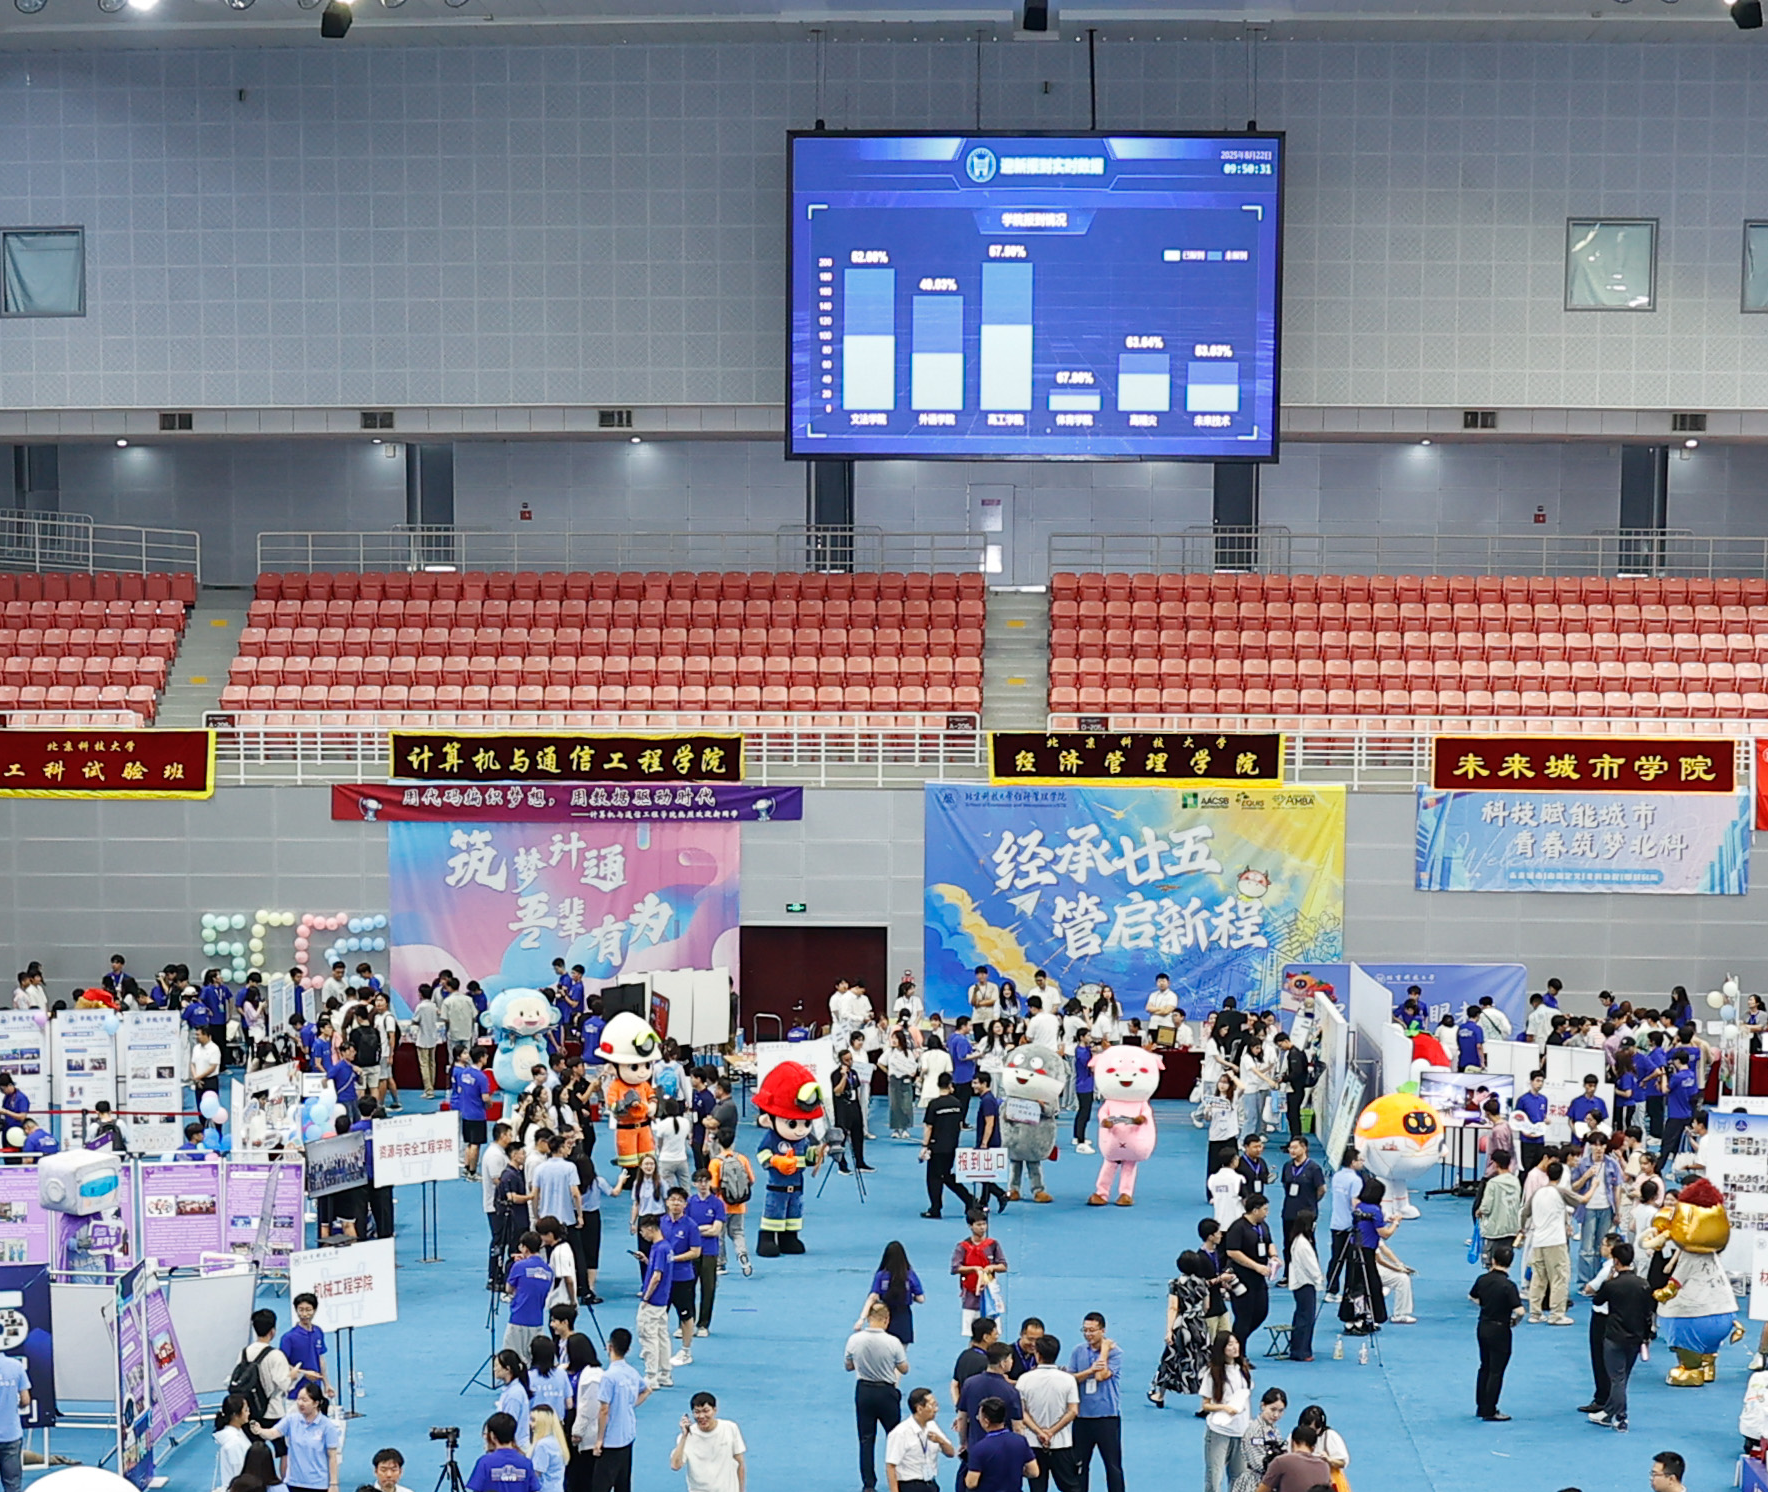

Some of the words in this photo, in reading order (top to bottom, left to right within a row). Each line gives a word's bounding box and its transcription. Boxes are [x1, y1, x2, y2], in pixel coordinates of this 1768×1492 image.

[1223, 164, 1272, 174] 09:50:31
[46, 740, 136, 753] 北京科技大学
[1046, 737, 1228, 749] 北京科技大学
[3, 760, 185, 782] 工科试验班
[406, 741, 730, 775] 计算机与通信工程学院
[1014, 749, 1261, 775] 经济管理学院
[1452, 753, 1718, 781] 未来城市学院
[1201, 797, 1229, 807] AACSB
[1481, 800, 1657, 827] 科技赋能城市
[991, 823, 1224, 892] 经承廿五
[1511, 833, 1689, 859] 青春筑梦北科
[444, 828, 629, 895] 筑梦计通
[507, 893, 675, 965] 吾辈有为
[1054, 891, 1270, 961] 管启新程
[379, 1138, 453, 1160] 资源与安全工程学院
[958, 1151, 1006, 1170] 报到出口
[313, 1274, 373, 1299] 机械工程学院
